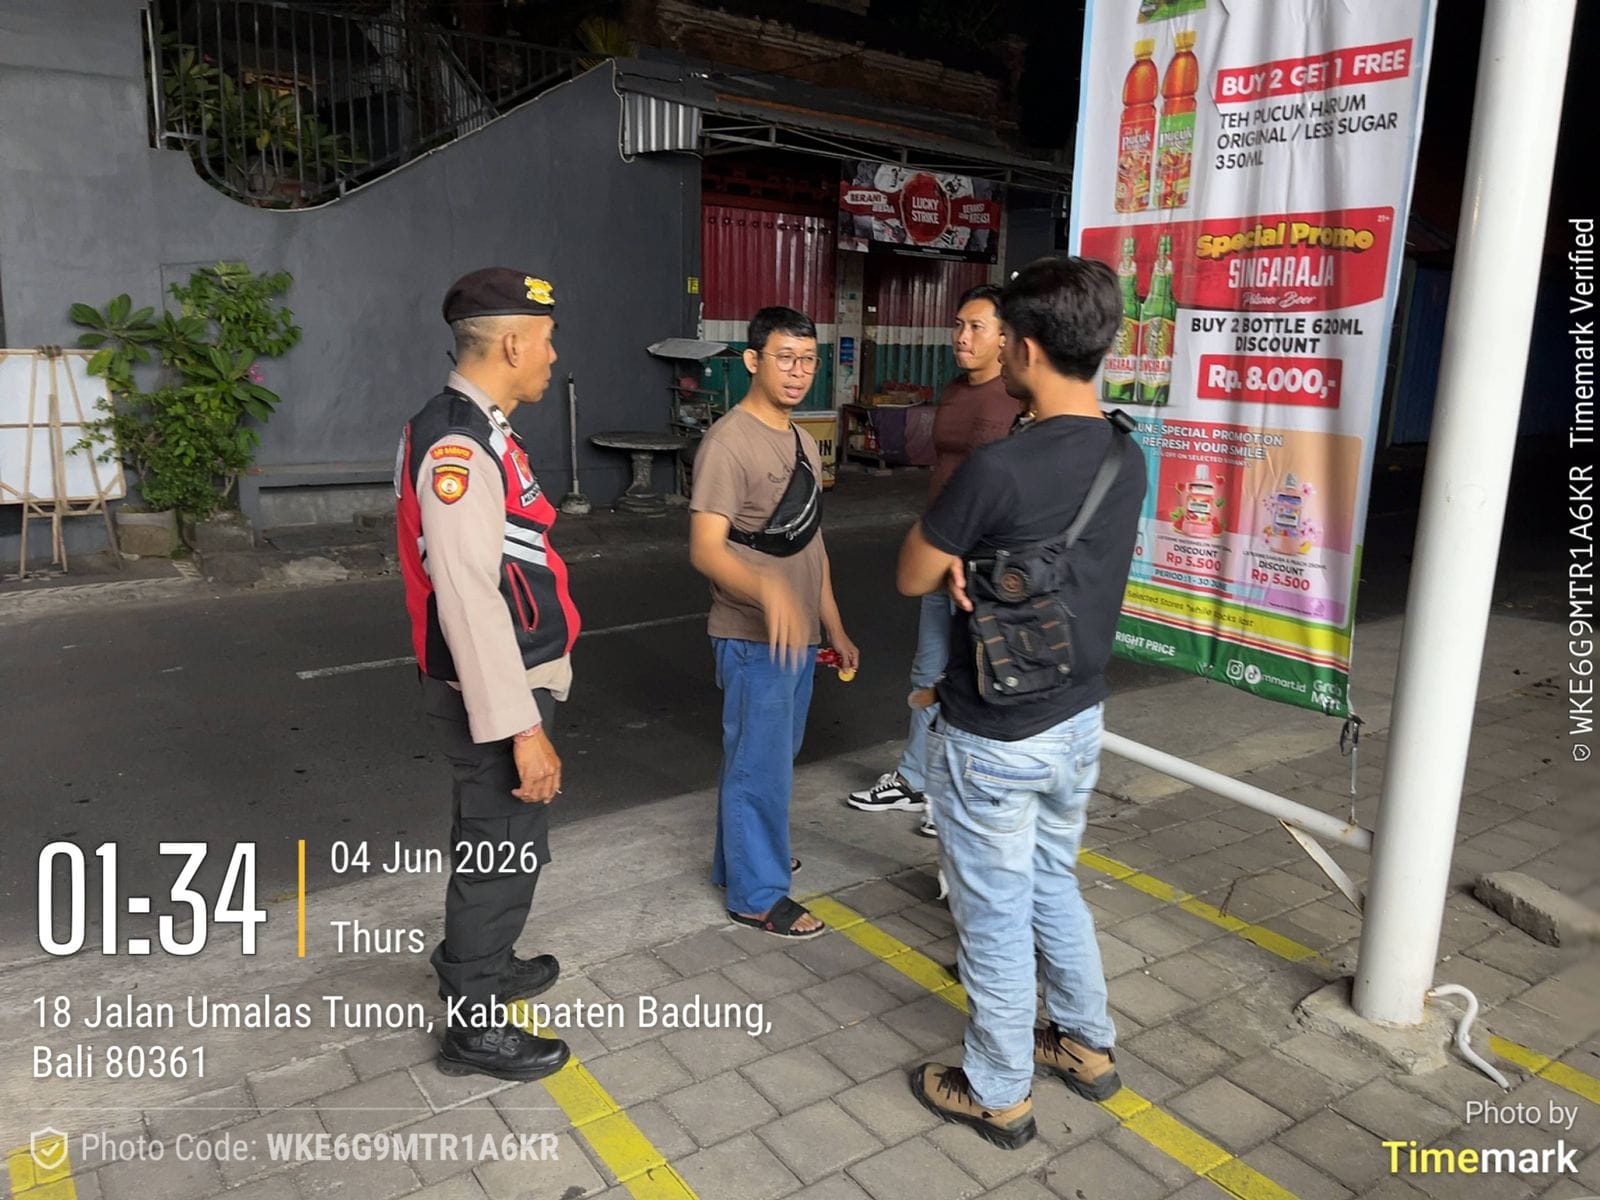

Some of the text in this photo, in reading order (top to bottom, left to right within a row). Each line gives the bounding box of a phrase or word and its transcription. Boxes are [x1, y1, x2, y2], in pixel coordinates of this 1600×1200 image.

[1222, 49, 1406, 96] BUY 2 GET 1 FREE
[1220, 94, 1366, 130] TEH PUCUK HARUM
[1217, 127, 1287, 150] ORIGINAL
[1305, 121, 1333, 140] LESS
[1338, 112, 1398, 135] SUGAR
[1215, 150, 1264, 169] 350ML
[912, 196, 939, 211] LUCKY
[911, 209, 940, 225] STRIKE
[1289, 222, 1375, 251] Promo
[1228, 255, 1334, 289] SINGARAJA
[1279, 290, 1317, 309] Beer
[1191, 318, 1363, 335] BUY 2 BOTTLE 620ML
[1235, 336, 1321, 353] DISCOUNT
[1208, 364, 1336, 399] Rp. 8.000,-
[1142, 436, 1190, 450] REFRESH
[1193, 441, 1230, 454] YOUR
[1162, 425, 1209, 439] SPECIAL
[1212, 429, 1283, 446] PROMOTON
[1188, 454, 1223, 464] SELECTED
[1173, 544, 1218, 557] DISCOUNT
[1166, 552, 1222, 571] Rp 5.500
[1258, 561, 1304, 576] DISCOUNT
[1155, 569, 1183, 581] PERIOD
[1251, 568, 1310, 591] Rp 5.500
[1115, 631, 1176, 657] RIGHT PRICE
